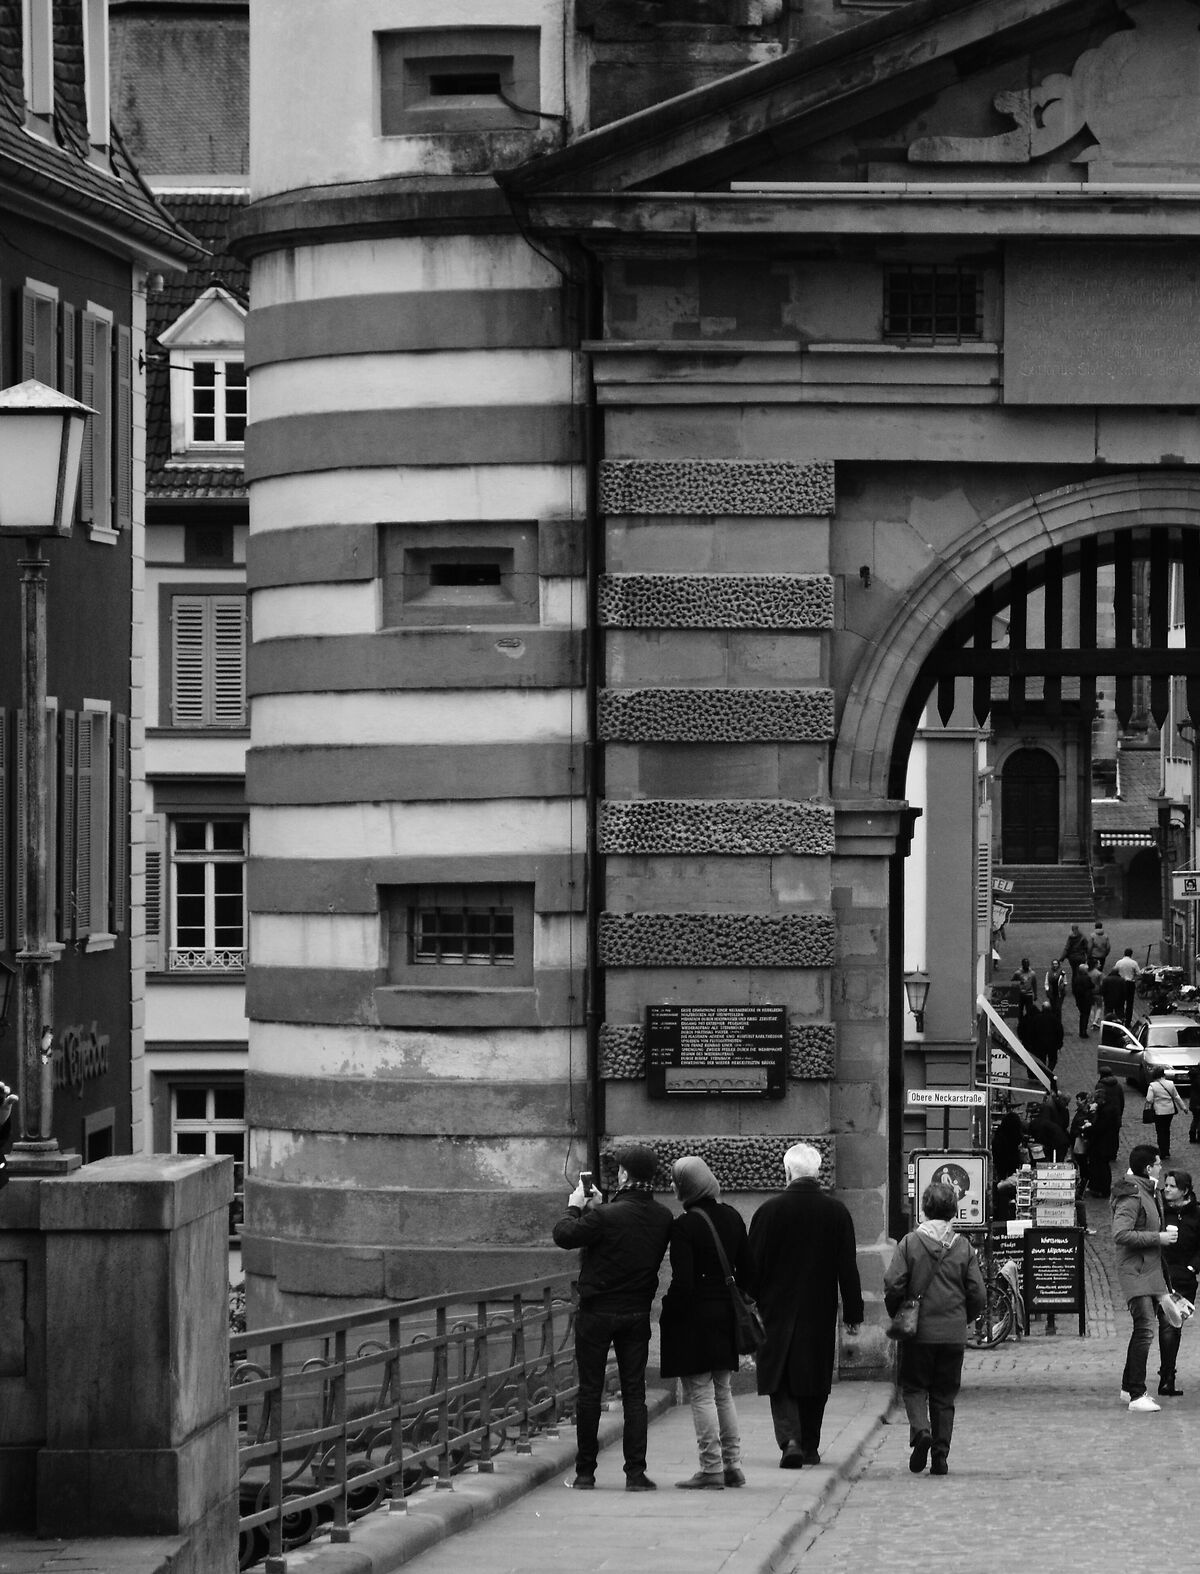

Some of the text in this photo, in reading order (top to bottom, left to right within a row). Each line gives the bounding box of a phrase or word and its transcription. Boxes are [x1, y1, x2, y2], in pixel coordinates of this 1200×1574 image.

[992, 878, 1011, 892] TEL
[911, 1092, 982, 1103] Obere Neckarstraße
